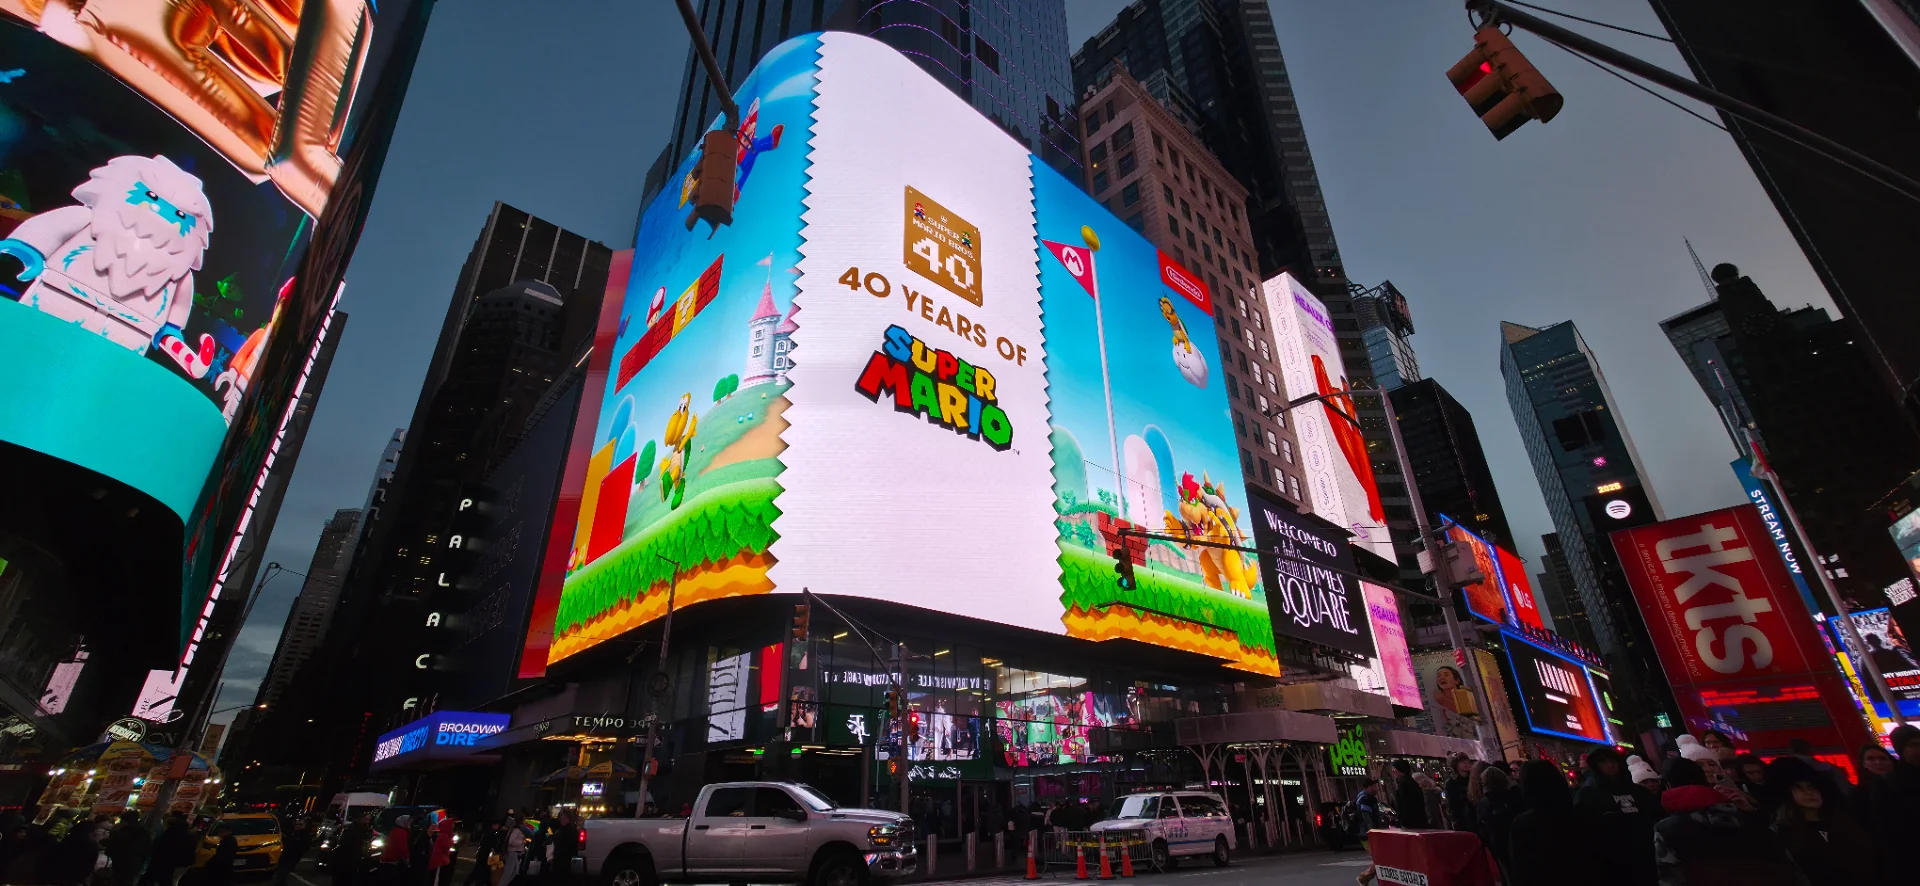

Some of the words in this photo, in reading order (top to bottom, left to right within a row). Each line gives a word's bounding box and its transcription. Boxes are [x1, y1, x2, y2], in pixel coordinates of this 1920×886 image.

[912, 218, 946, 243] MARIO
[948, 239, 976, 261] BROS.
[927, 216, 960, 242] SUPER
[912, 237, 974, 290] 40
[1169, 268, 1202, 299] Nintendo
[838, 266, 891, 298] 40
[901, 284, 987, 348] YEARS
[996, 336, 1027, 367] OF
[882, 324, 998, 405] SUPER
[855, 350, 1013, 452] MARIO
[1264, 509, 1323, 552] WELCOME
[1322, 540, 1337, 557] TO
[1750, 489, 1786, 540] STREAM
[1779, 541, 1802, 574] NOW
[1655, 523, 1774, 674] tkts
[439, 722, 505, 734] BROADWAY
[574, 715, 624, 730] TEMPO
[1341, 766, 1366, 776] SOCCER
